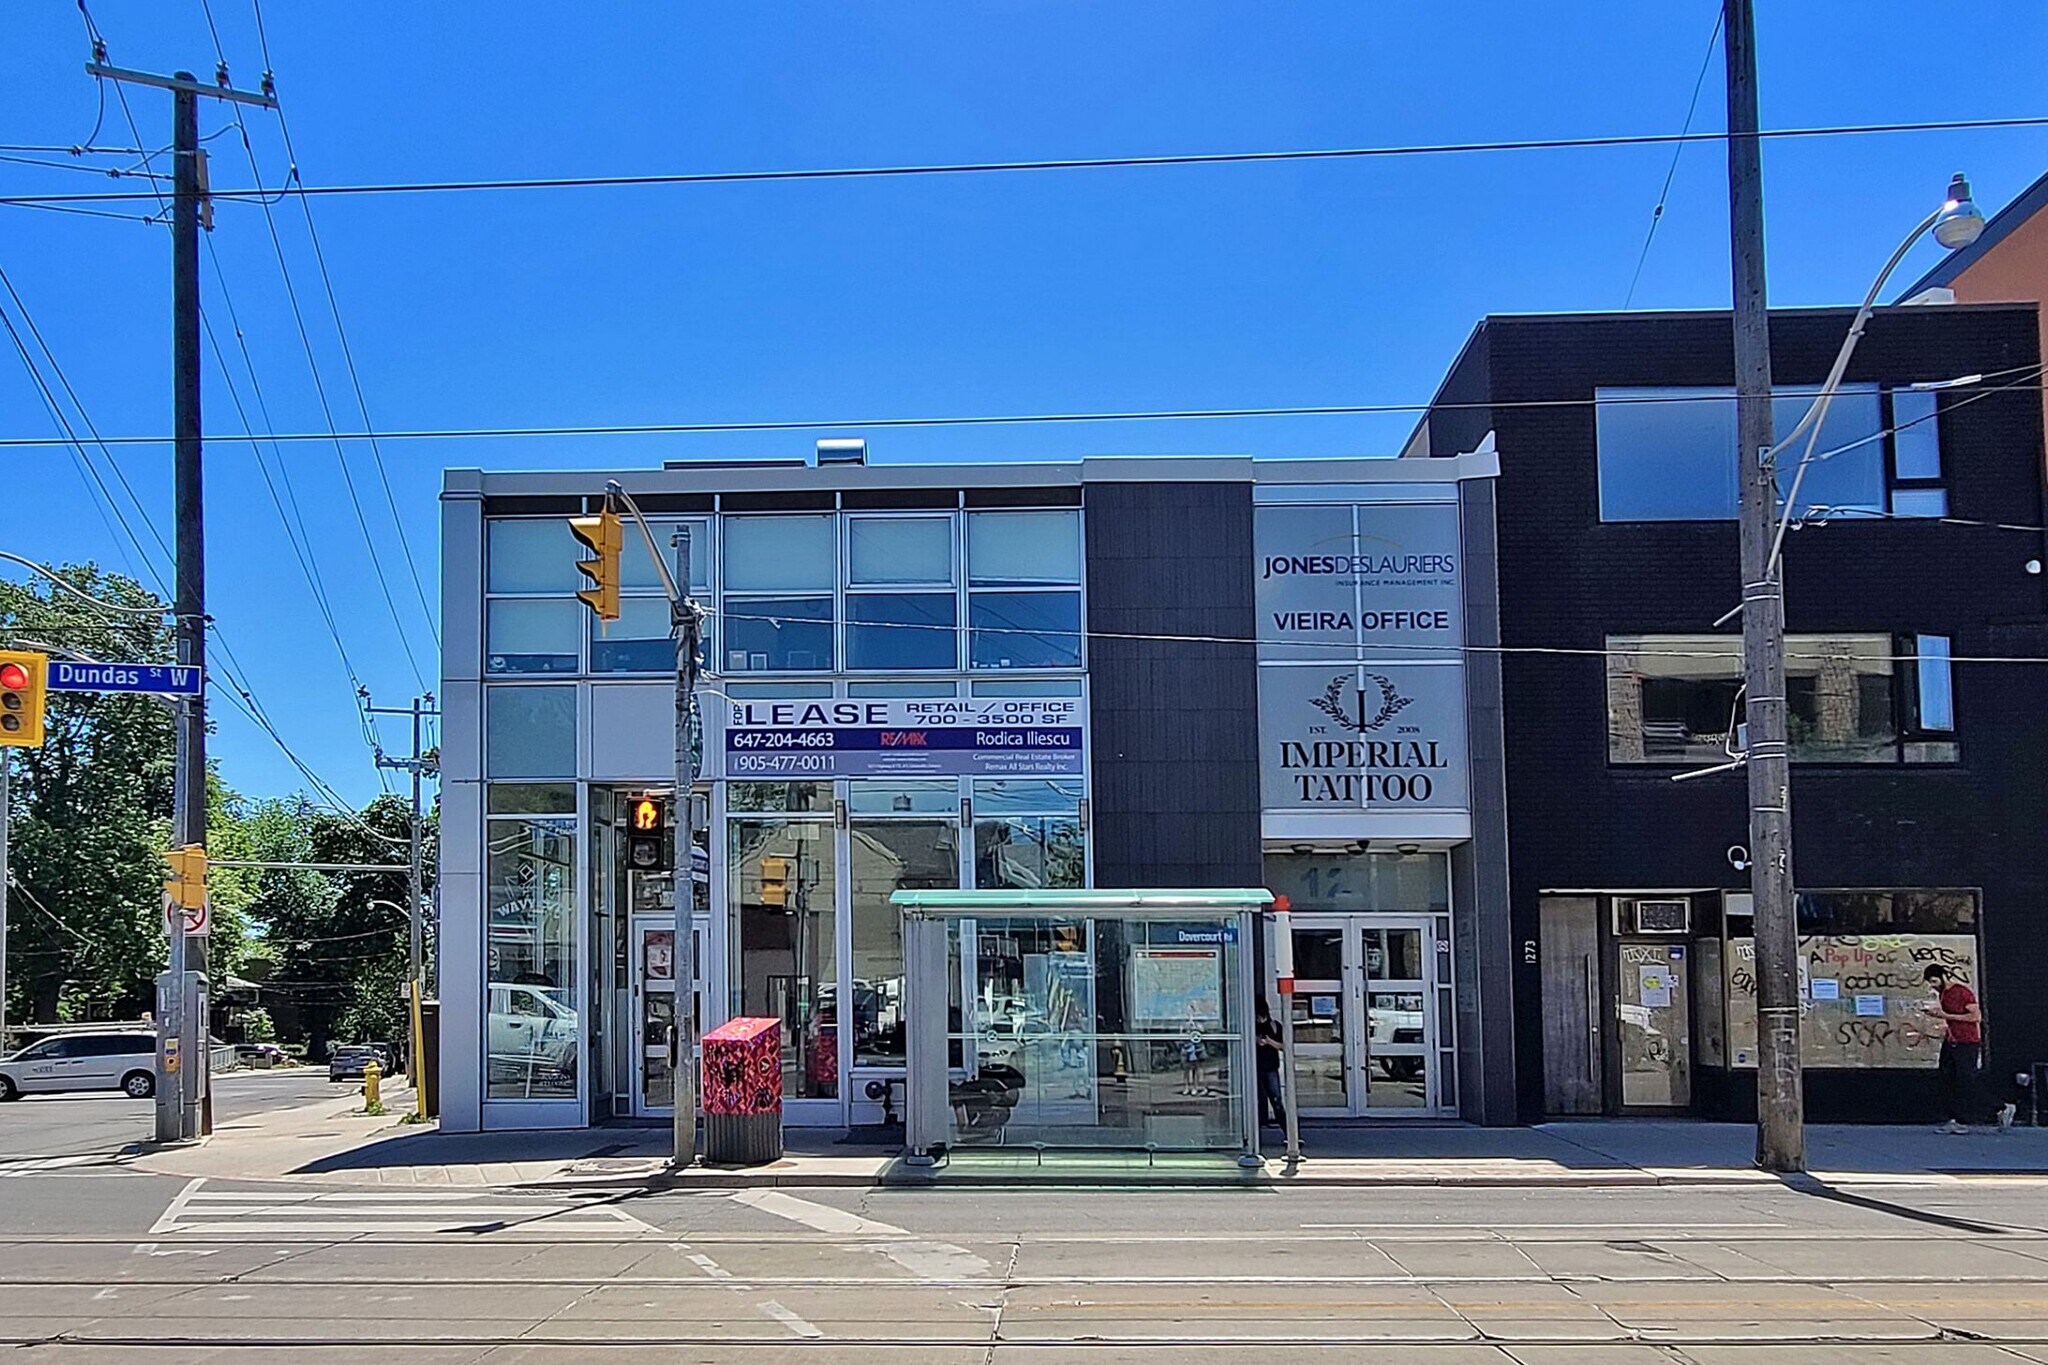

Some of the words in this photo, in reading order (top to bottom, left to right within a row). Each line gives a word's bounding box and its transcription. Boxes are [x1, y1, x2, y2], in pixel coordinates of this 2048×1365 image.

[1383, 579, 1438, 587] MANAGEMENT
[1273, 612, 1354, 631] VIEIRA
[1361, 611, 1449, 630] OFFICE
[59, 664, 139, 684] Dundas
[150, 667, 162, 677] St
[170, 668, 189, 687] W
[745, 703, 888, 725] LEASE
[906, 703, 976, 713] RETAIL
[1003, 702, 1075, 712] OFFICE
[914, 715, 957, 725] 700
[977, 714, 1034, 724] 3500
[1041, 714, 1068, 724] SF
[733, 733, 834, 747] 647-204-4663
[880, 731, 928, 746] RE/MAX
[976, 732, 1023, 746] Rodica
[973, 753, 1014, 761] Commercial
[1016, 753, 1029, 761] Real
[1031, 753, 1051, 761] Estate
[1280, 741, 1447, 768] IMPERIAL
[1294, 775, 1432, 801] TATTOO
[1178, 931, 1222, 942] Dovercourt
[1525, 940, 1536, 963] 1273
[1825, 948, 1850, 967] Pop
[1854, 949, 1873, 967] Up
